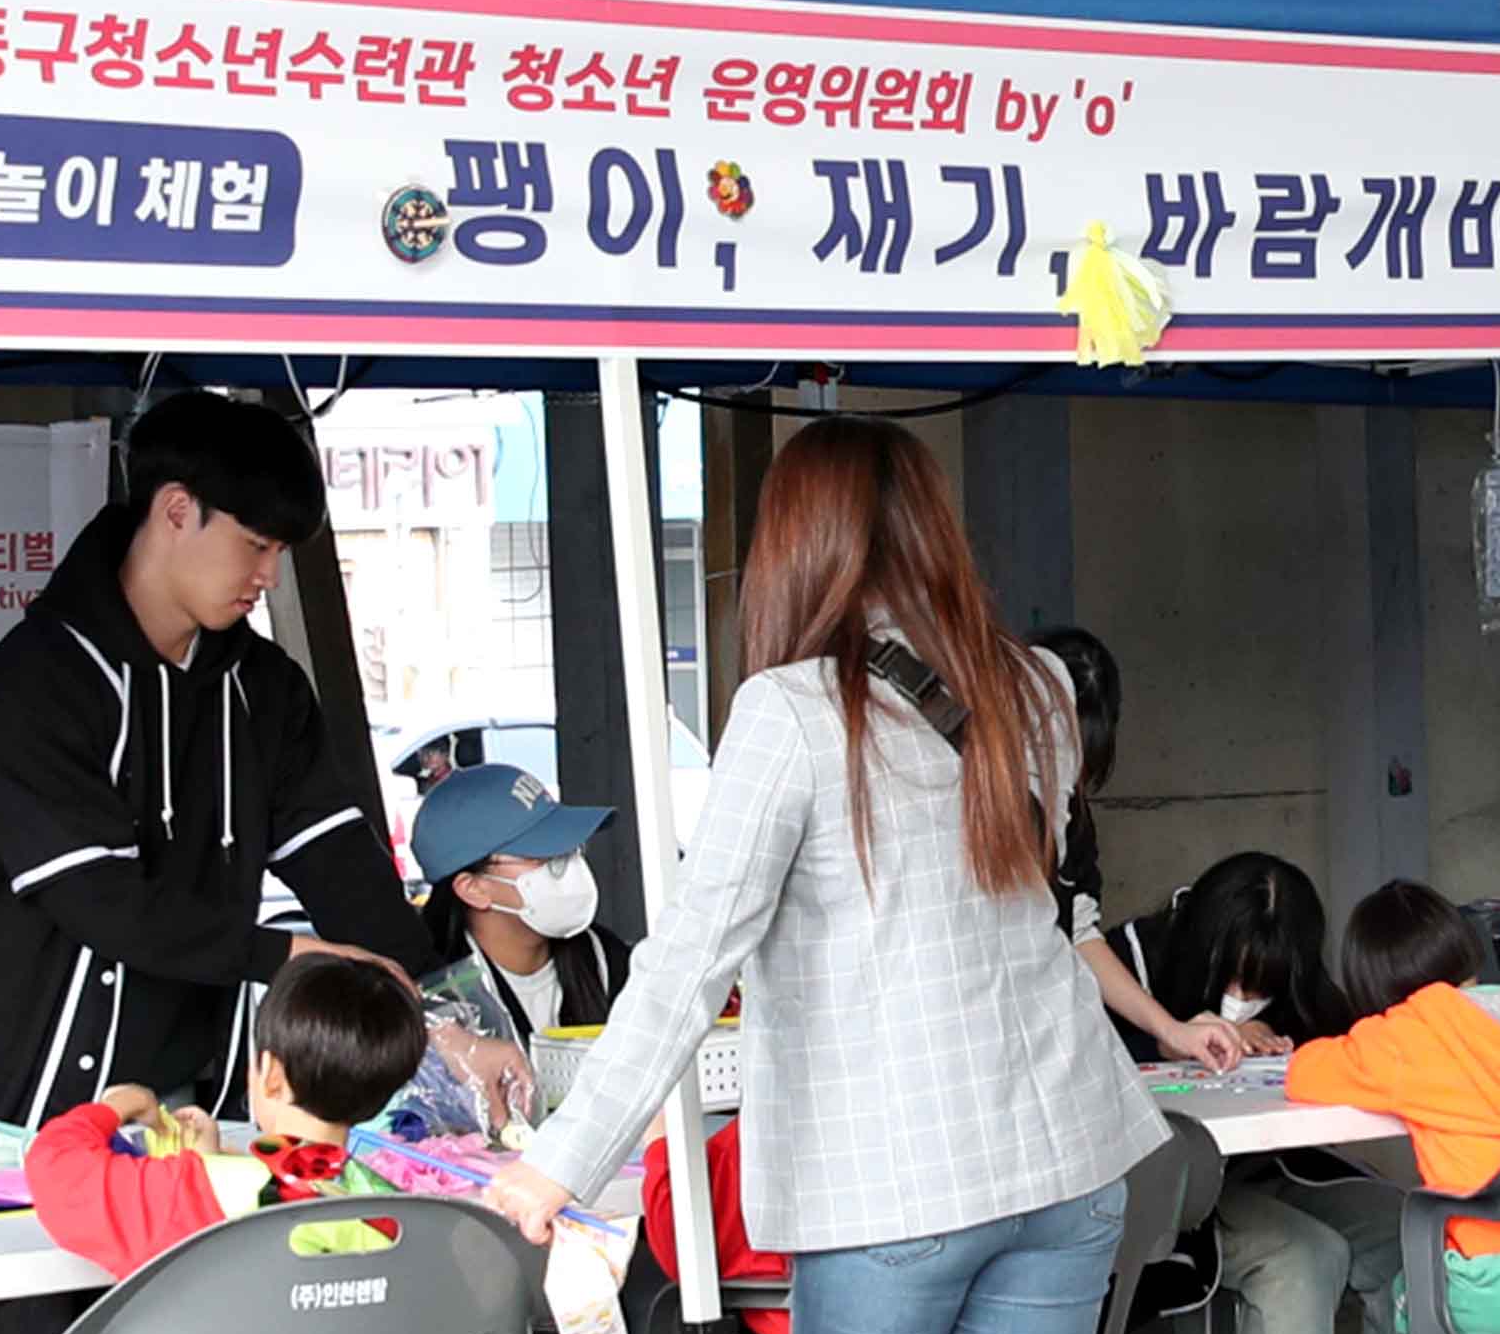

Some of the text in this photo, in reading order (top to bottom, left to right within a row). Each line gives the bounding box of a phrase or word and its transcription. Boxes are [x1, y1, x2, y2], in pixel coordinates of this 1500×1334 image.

[502, 44, 682, 118] 청소년
[703, 56, 974, 134] 운영위원회
[994, 88, 1060, 141] by
[134, 157, 270, 233] 체험
